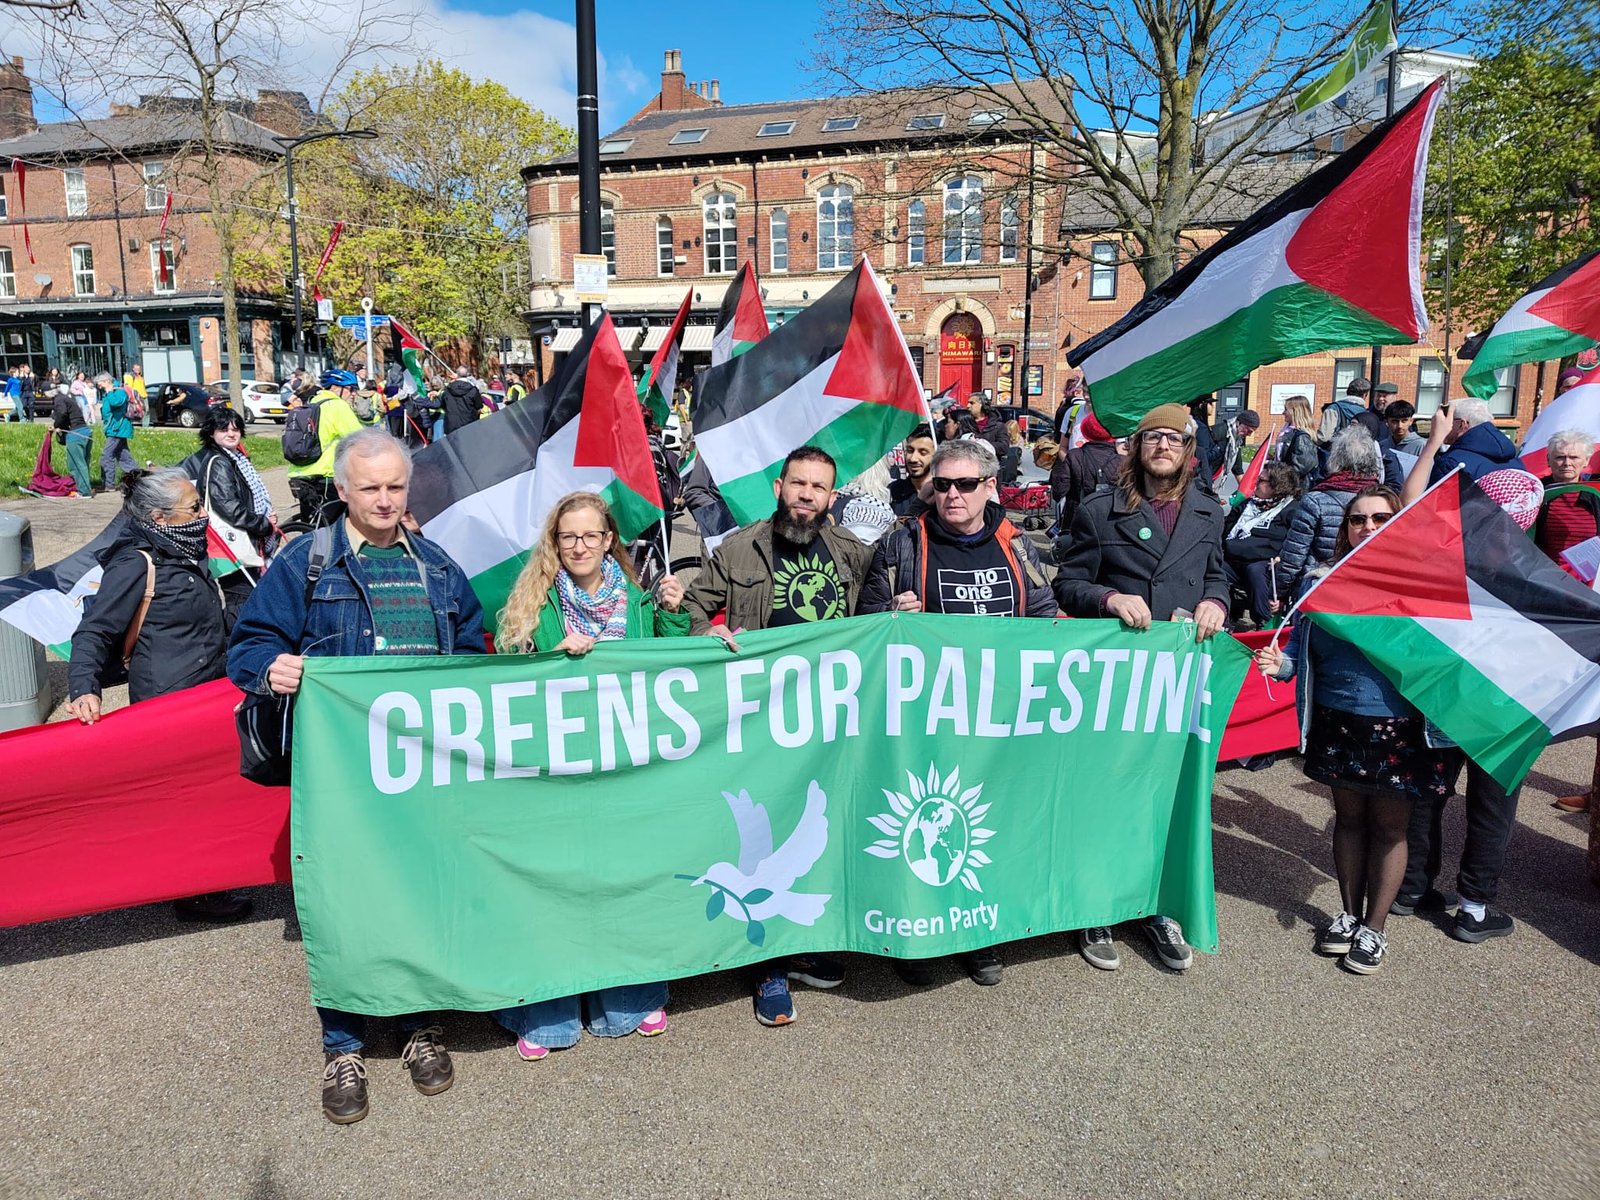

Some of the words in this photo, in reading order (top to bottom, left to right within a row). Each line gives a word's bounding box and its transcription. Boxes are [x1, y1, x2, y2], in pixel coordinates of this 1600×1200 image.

[974, 569, 998, 585] no
[955, 586, 993, 600] one
[972, 600, 987, 614] is
[368, 667, 702, 795] GREENS
[725, 648, 863, 754] FOR
[886, 643, 1213, 744] PALESTINE
[864, 909, 944, 937] Green
[948, 900, 999, 932] Party
